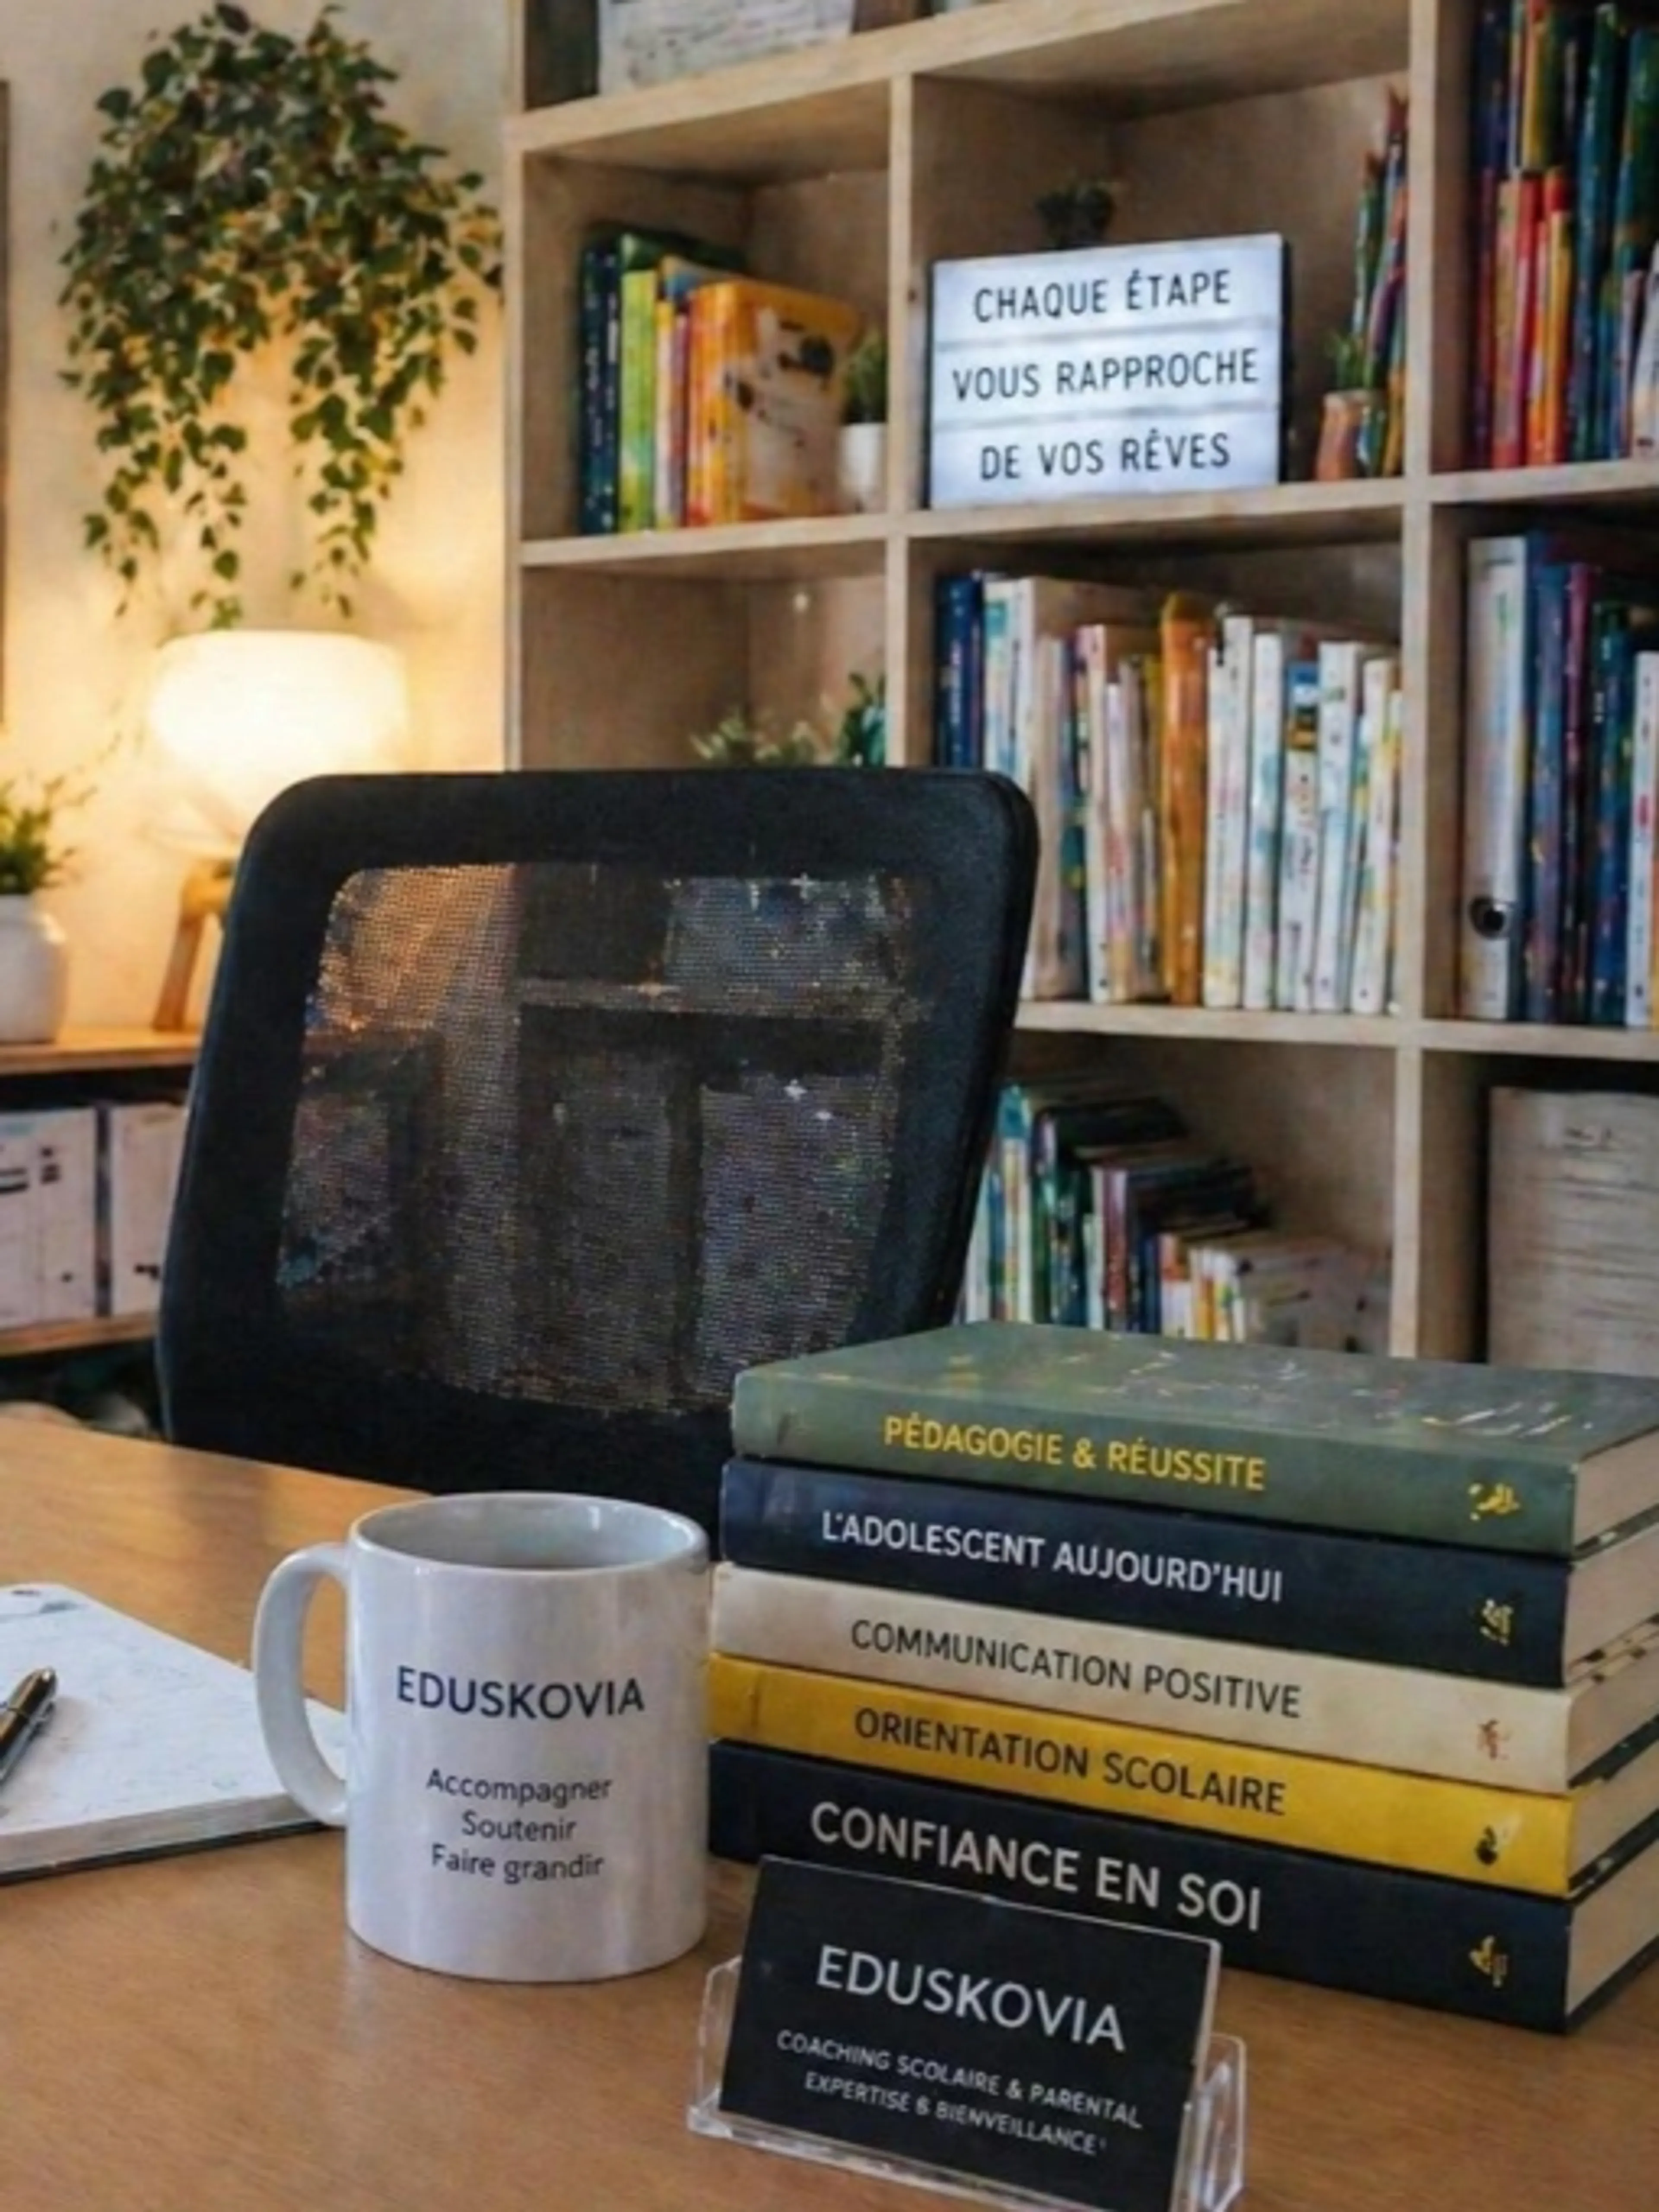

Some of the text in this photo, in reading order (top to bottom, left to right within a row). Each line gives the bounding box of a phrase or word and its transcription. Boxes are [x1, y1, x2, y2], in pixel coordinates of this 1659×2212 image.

[974, 269, 1231, 323] CHAQUE ÉTAPE
[953, 347, 1259, 401] VOUS RAPPROCHE
[981, 428, 1230, 480] DE VOS RÊVES
[884, 1413, 1265, 1491] PÉDAGOGIE & RÉUSSITE
[822, 1510, 1283, 1602] L'ADOLESCENT AUJOURD'HUI
[397, 1665, 644, 1720] EDUSKOVIA
[851, 1619, 1300, 1719] COMMUNICATION POSITIVE
[426, 1768, 613, 1808] Accompagner
[854, 1707, 1286, 1815] ORIENTATION SCOLAIRE
[461, 1811, 577, 1842] Soutenir
[432, 1844, 605, 1884] Faire grandir
[811, 1802, 1261, 1932] CONFIANCE EN SOI
[817, 1945, 1125, 2051] EDUSKOVIA
[777, 2029, 1142, 2128] COACHING SCOLAIRE & PARENTAL
[805, 2072, 909, 2113] EXPERTISE
